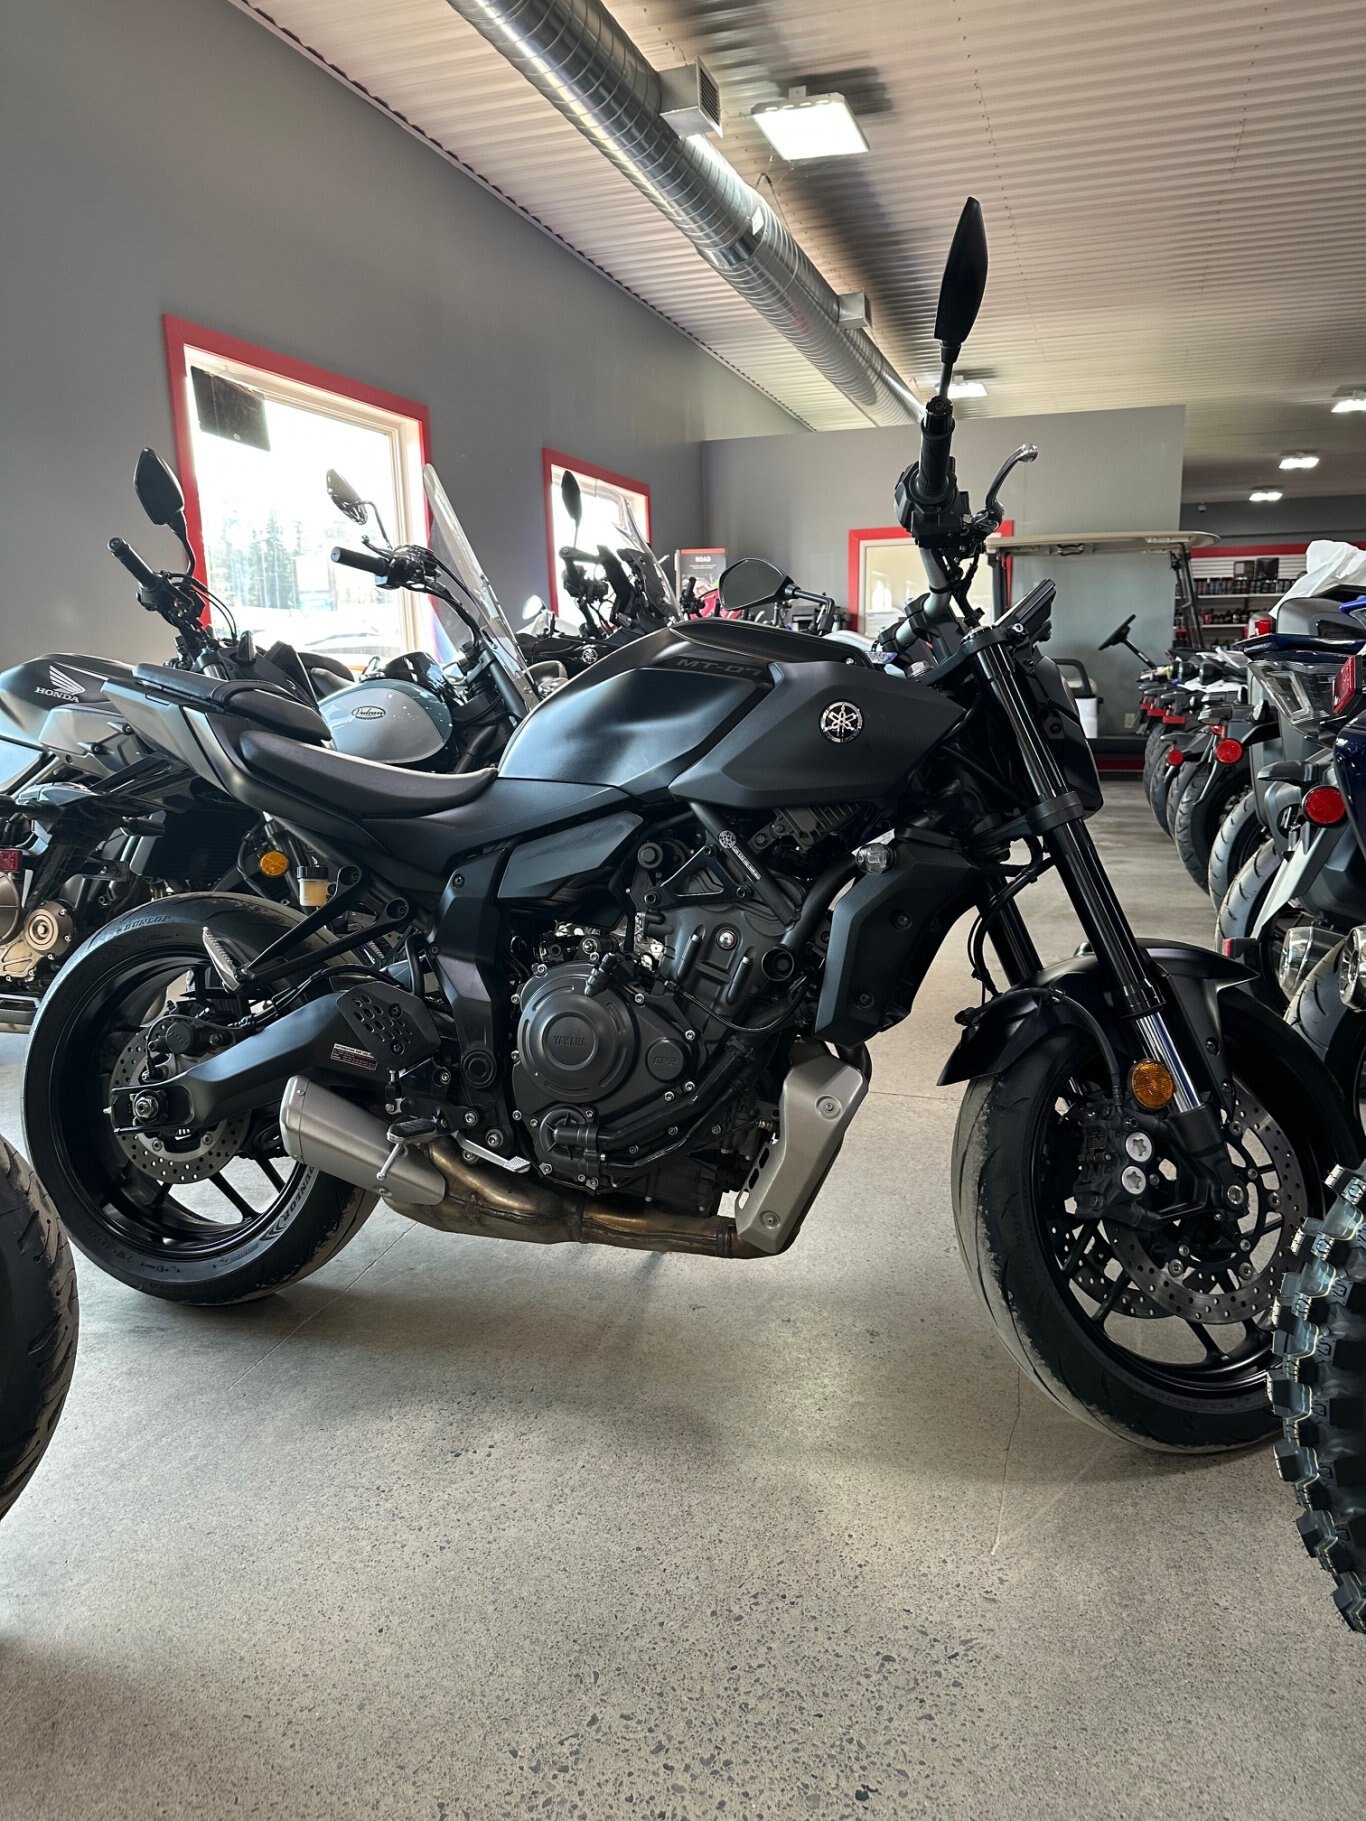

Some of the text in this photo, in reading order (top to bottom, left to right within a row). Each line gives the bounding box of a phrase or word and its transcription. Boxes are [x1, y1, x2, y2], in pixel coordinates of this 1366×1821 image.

[676, 659, 763, 676] MT-07
[34, 686, 80, 703] HONDA
[123, 915, 172, 932] DUNLOP
